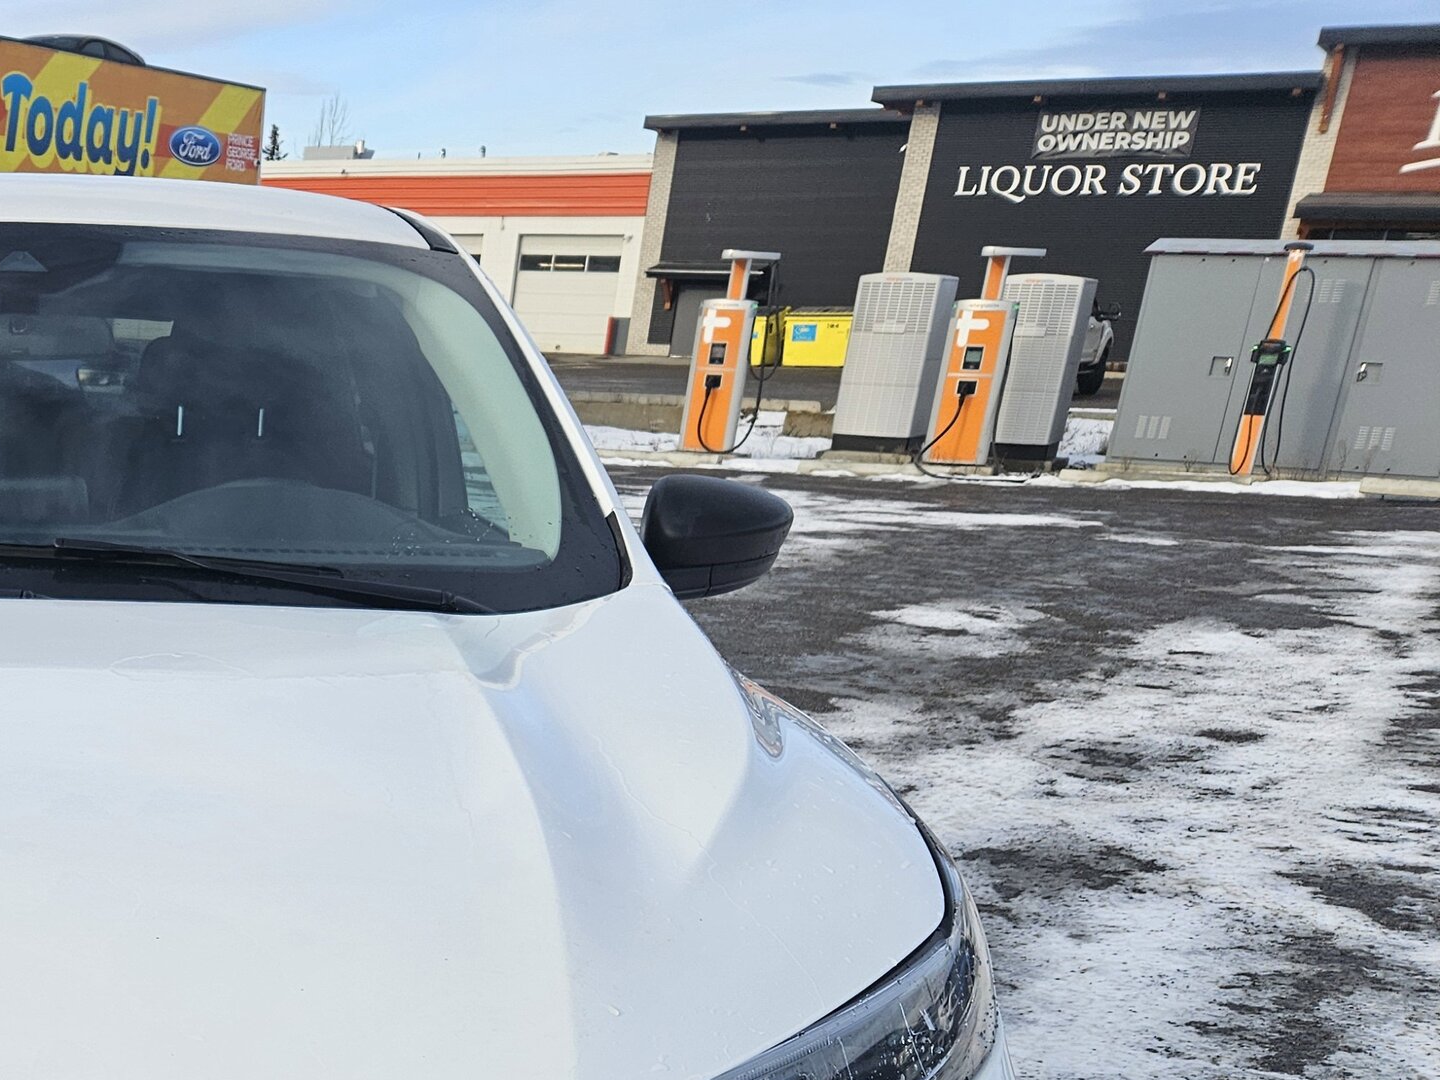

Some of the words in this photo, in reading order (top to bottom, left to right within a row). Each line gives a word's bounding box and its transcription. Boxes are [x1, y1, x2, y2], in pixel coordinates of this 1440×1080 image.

[1, 73, 158, 176] Today!
[1041, 112, 1127, 132] UNDER
[1133, 111, 1196, 130] NEW
[178, 131, 214, 161] Ford
[1037, 131, 1190, 151] OWNERSHIP
[954, 165, 1107, 203] LIQUOR
[1116, 163, 1262, 196] STORE
